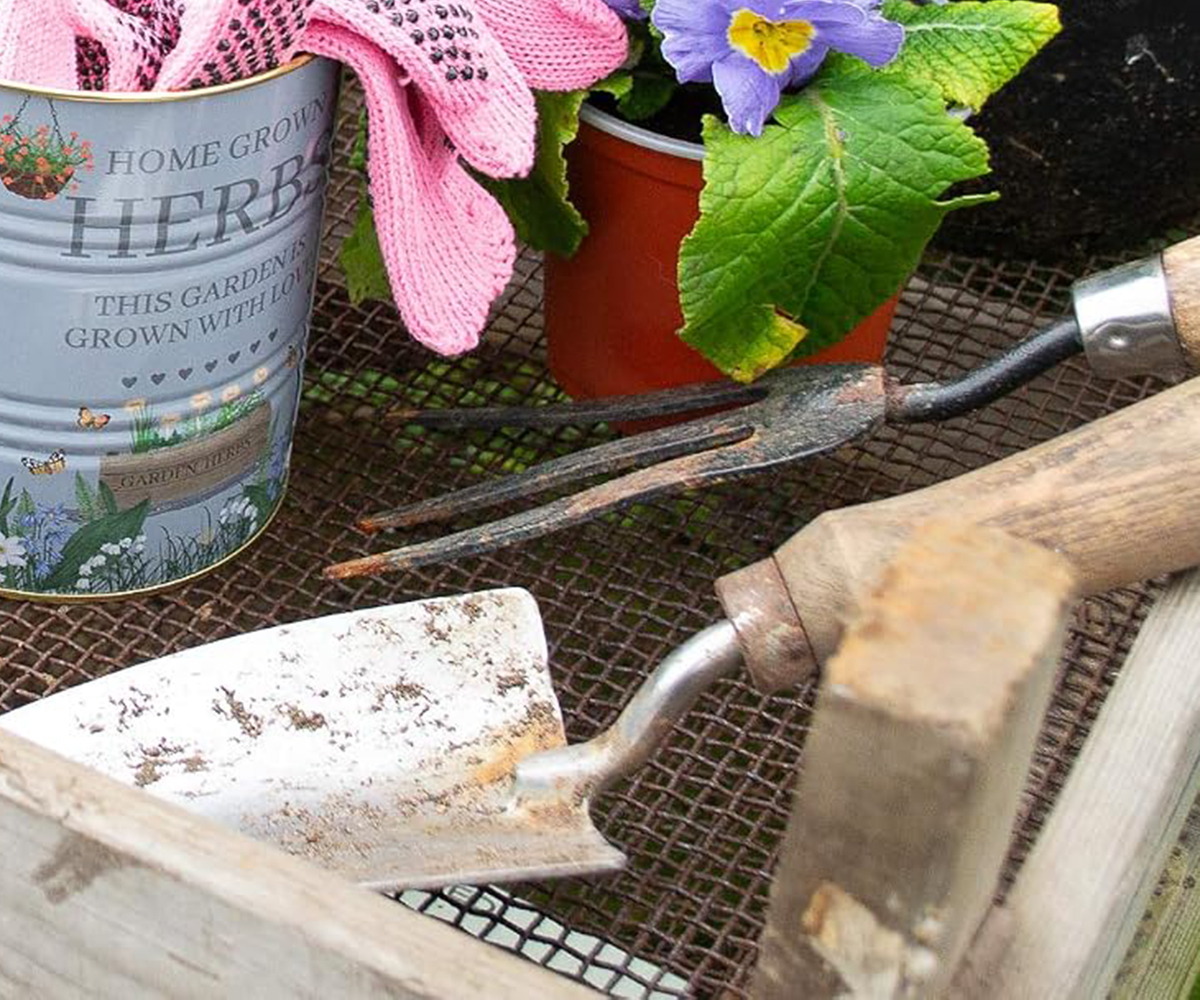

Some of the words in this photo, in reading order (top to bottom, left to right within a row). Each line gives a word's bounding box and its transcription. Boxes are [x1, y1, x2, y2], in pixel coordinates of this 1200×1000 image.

[105, 140, 221, 176] HOME
[229, 93, 328, 160] GROWN
[95, 291, 172, 317] THIS
[180, 250, 289, 309] GARDEN
[64, 318, 193, 350] GROWN
[199, 291, 267, 336] WITH
[120, 460, 199, 488] GARDEN
